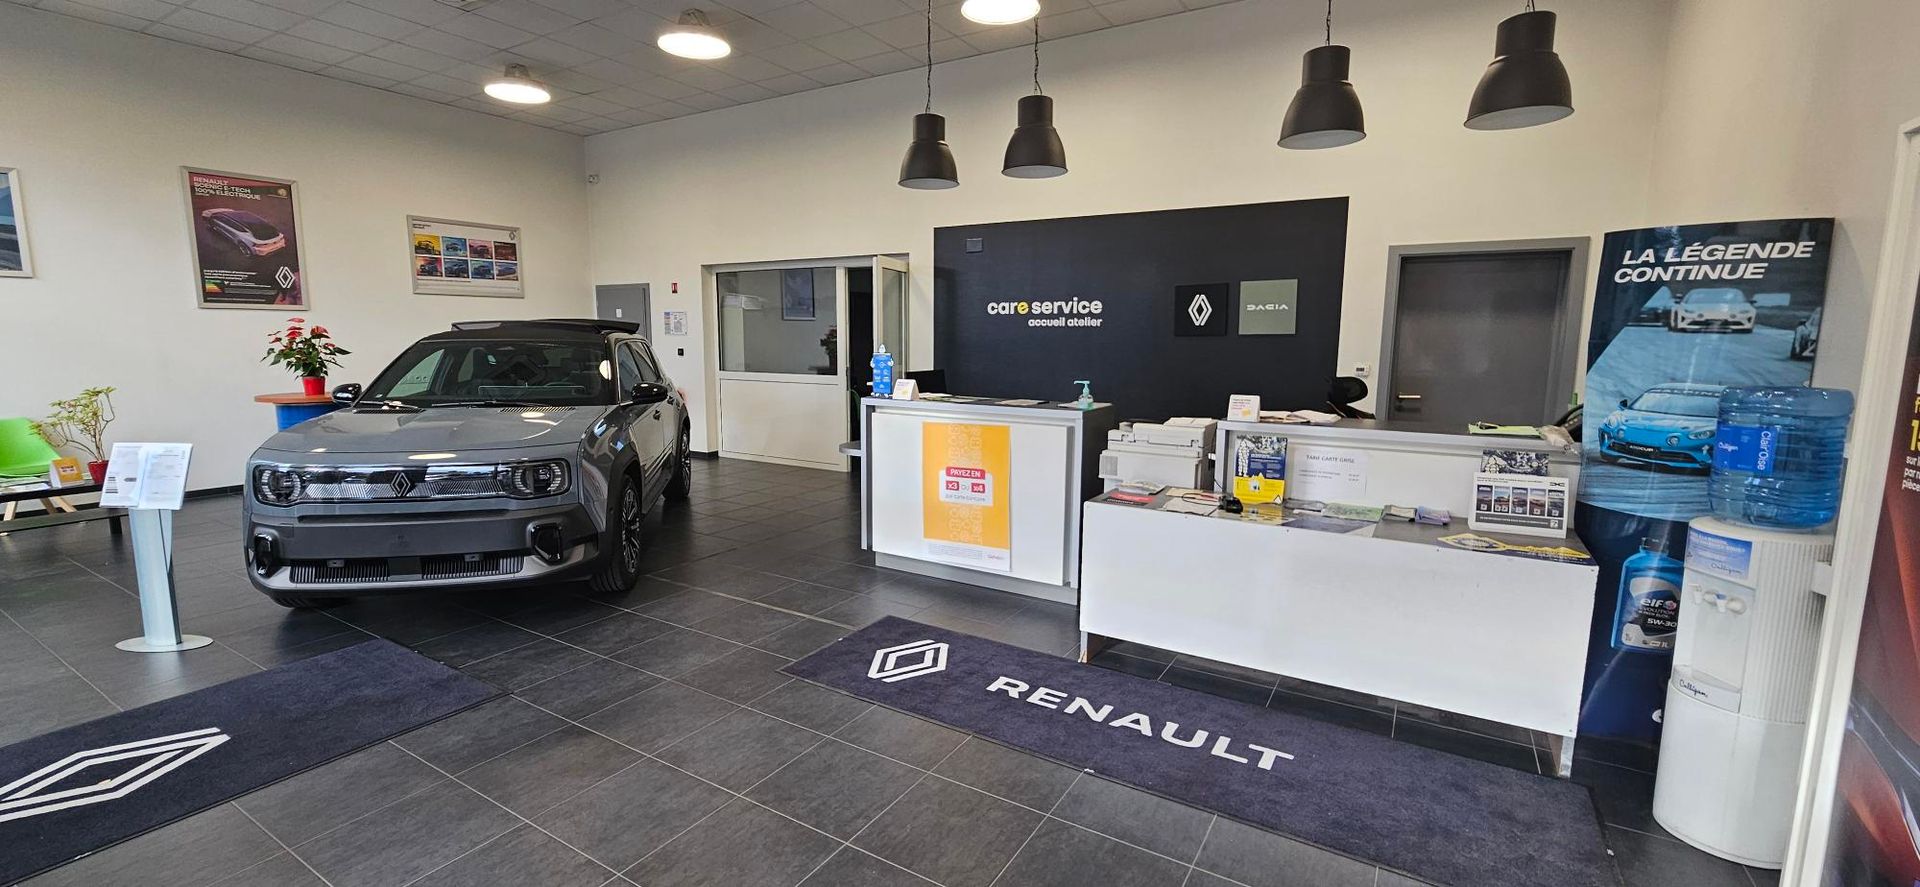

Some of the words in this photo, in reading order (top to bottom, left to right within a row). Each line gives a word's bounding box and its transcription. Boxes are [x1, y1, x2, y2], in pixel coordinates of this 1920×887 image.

[1622, 249, 1656, 265] LA
[1663, 241, 1816, 263] LÉGENDE
[1614, 262, 1768, 283] CONTINUE
[987, 301, 1030, 315] care
[1031, 296, 1103, 315] service
[1028, 317, 1066, 327] accueil
[1067, 317, 1103, 327] atelier
[950, 468, 971, 477] PAYEZ
[971, 470, 981, 478] EN
[1640, 598, 1664, 608] elf
[986, 676, 1295, 771] RENAULT
